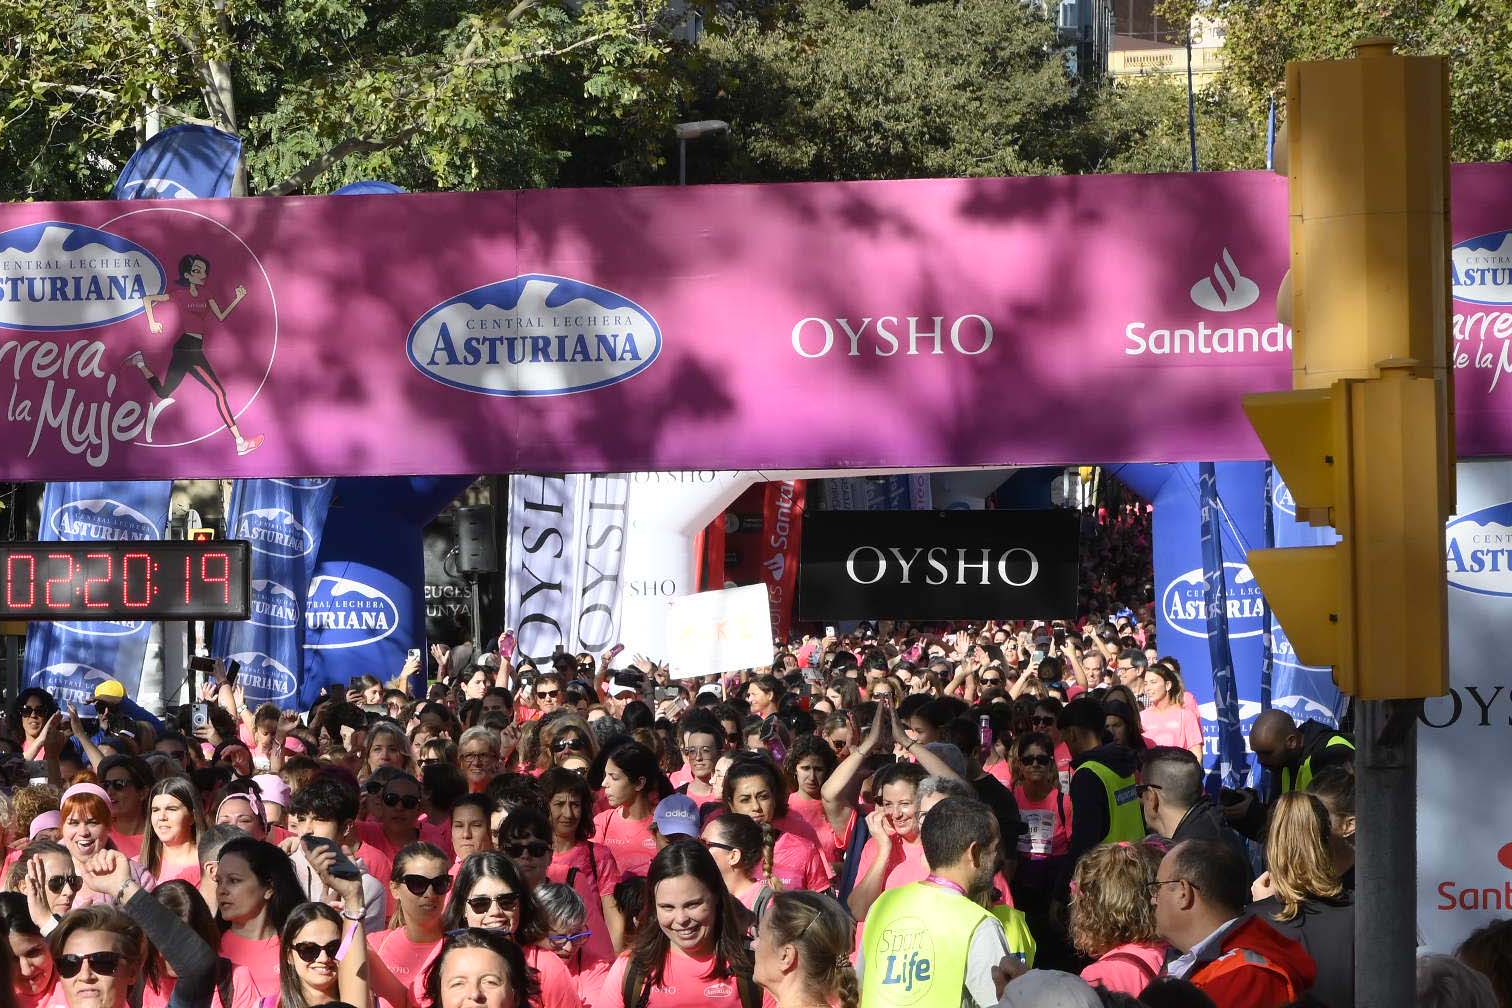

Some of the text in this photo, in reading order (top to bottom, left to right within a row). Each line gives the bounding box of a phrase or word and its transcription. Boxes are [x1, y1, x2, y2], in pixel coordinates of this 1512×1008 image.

[70, 258, 141, 269] LECHERA
[466, 315, 633, 330] CENTRAL LECHERA
[791, 314, 993, 358] OYSHO
[426, 322, 642, 366] ASTURIANA
[7, 383, 31, 421] la
[28, 370, 177, 468] Mujer
[6, 553, 229, 607] 02:20:19
[846, 546, 1039, 587] OYSHO
[336, 601, 384, 609] LECHERA
[880, 929, 928, 952] Sport
[881, 951, 931, 992] Life
